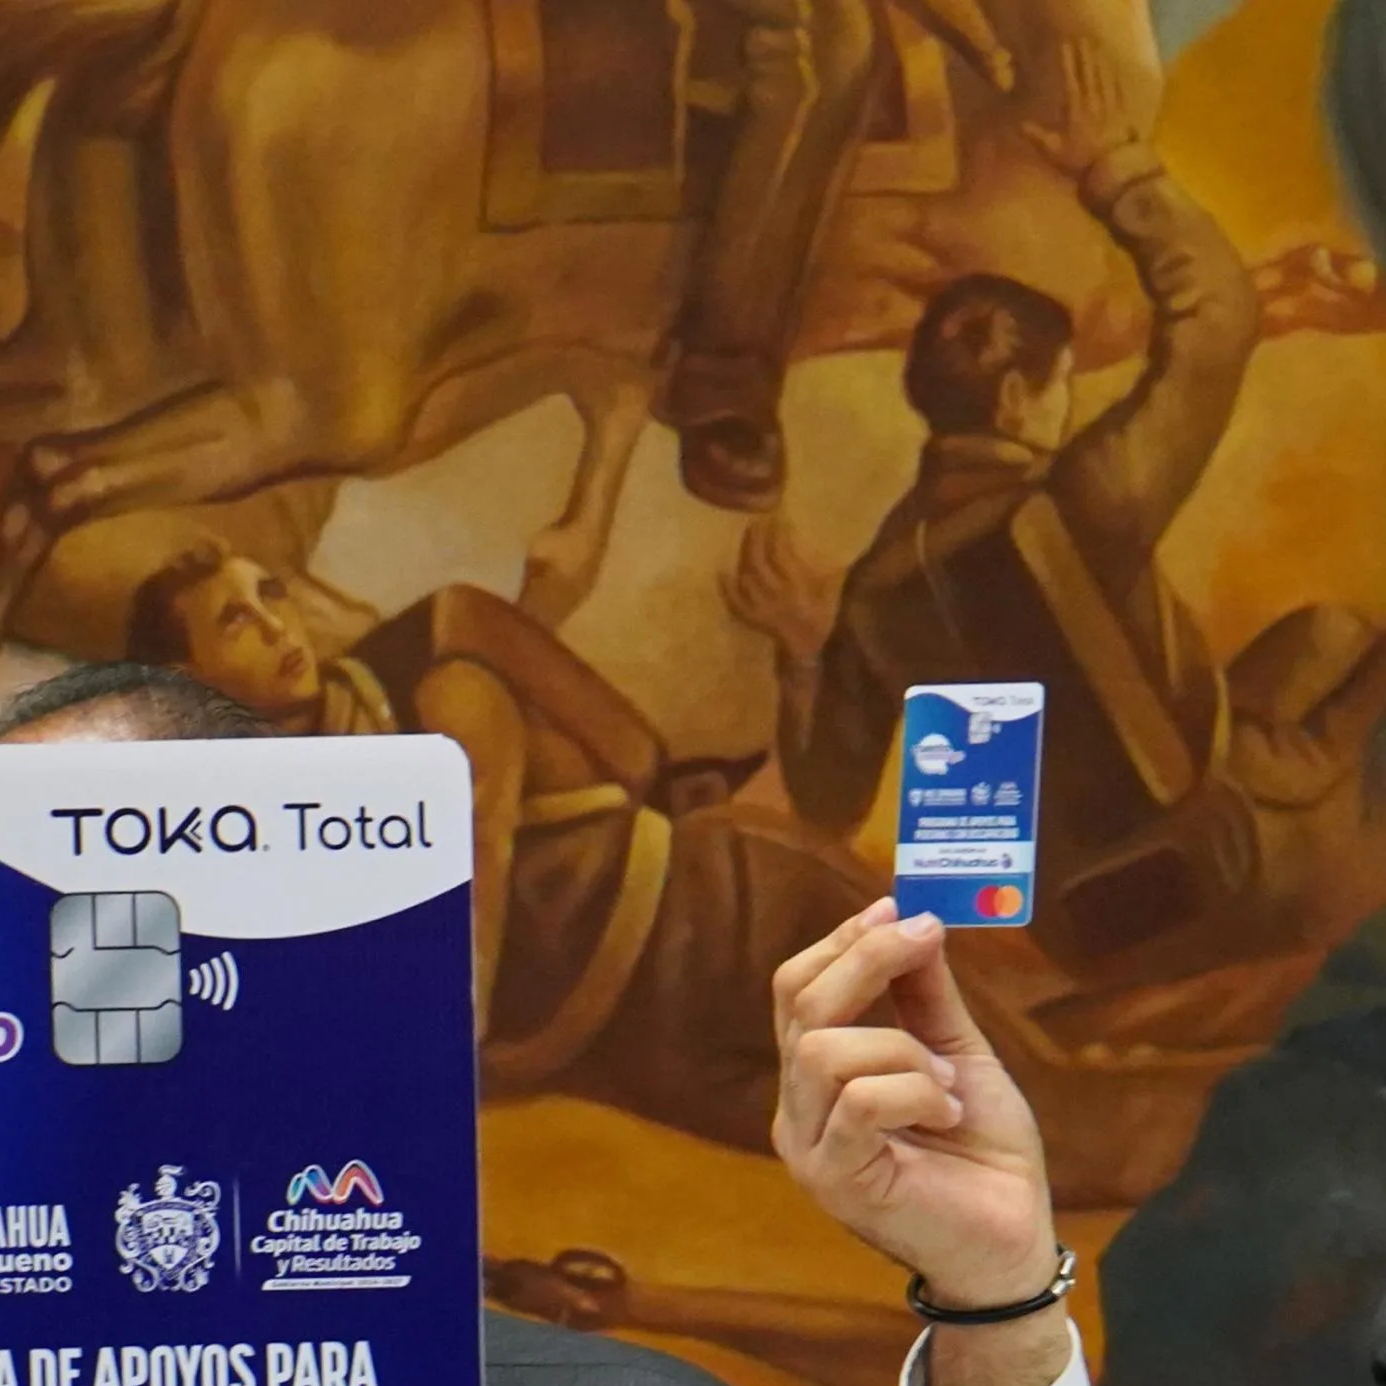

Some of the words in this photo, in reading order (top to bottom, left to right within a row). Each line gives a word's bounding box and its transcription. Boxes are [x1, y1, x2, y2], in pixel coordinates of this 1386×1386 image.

[51, 804, 258, 856] TOKA
[285, 800, 432, 851] Total
[267, 1208, 403, 1233] Chihuahua
[250, 1235, 320, 1256] Capital
[324, 1235, 347, 1252] de
[349, 1232, 421, 1253] Trabajo
[276, 1256, 290, 1276] y
[291, 1254, 395, 1272] Resultados
